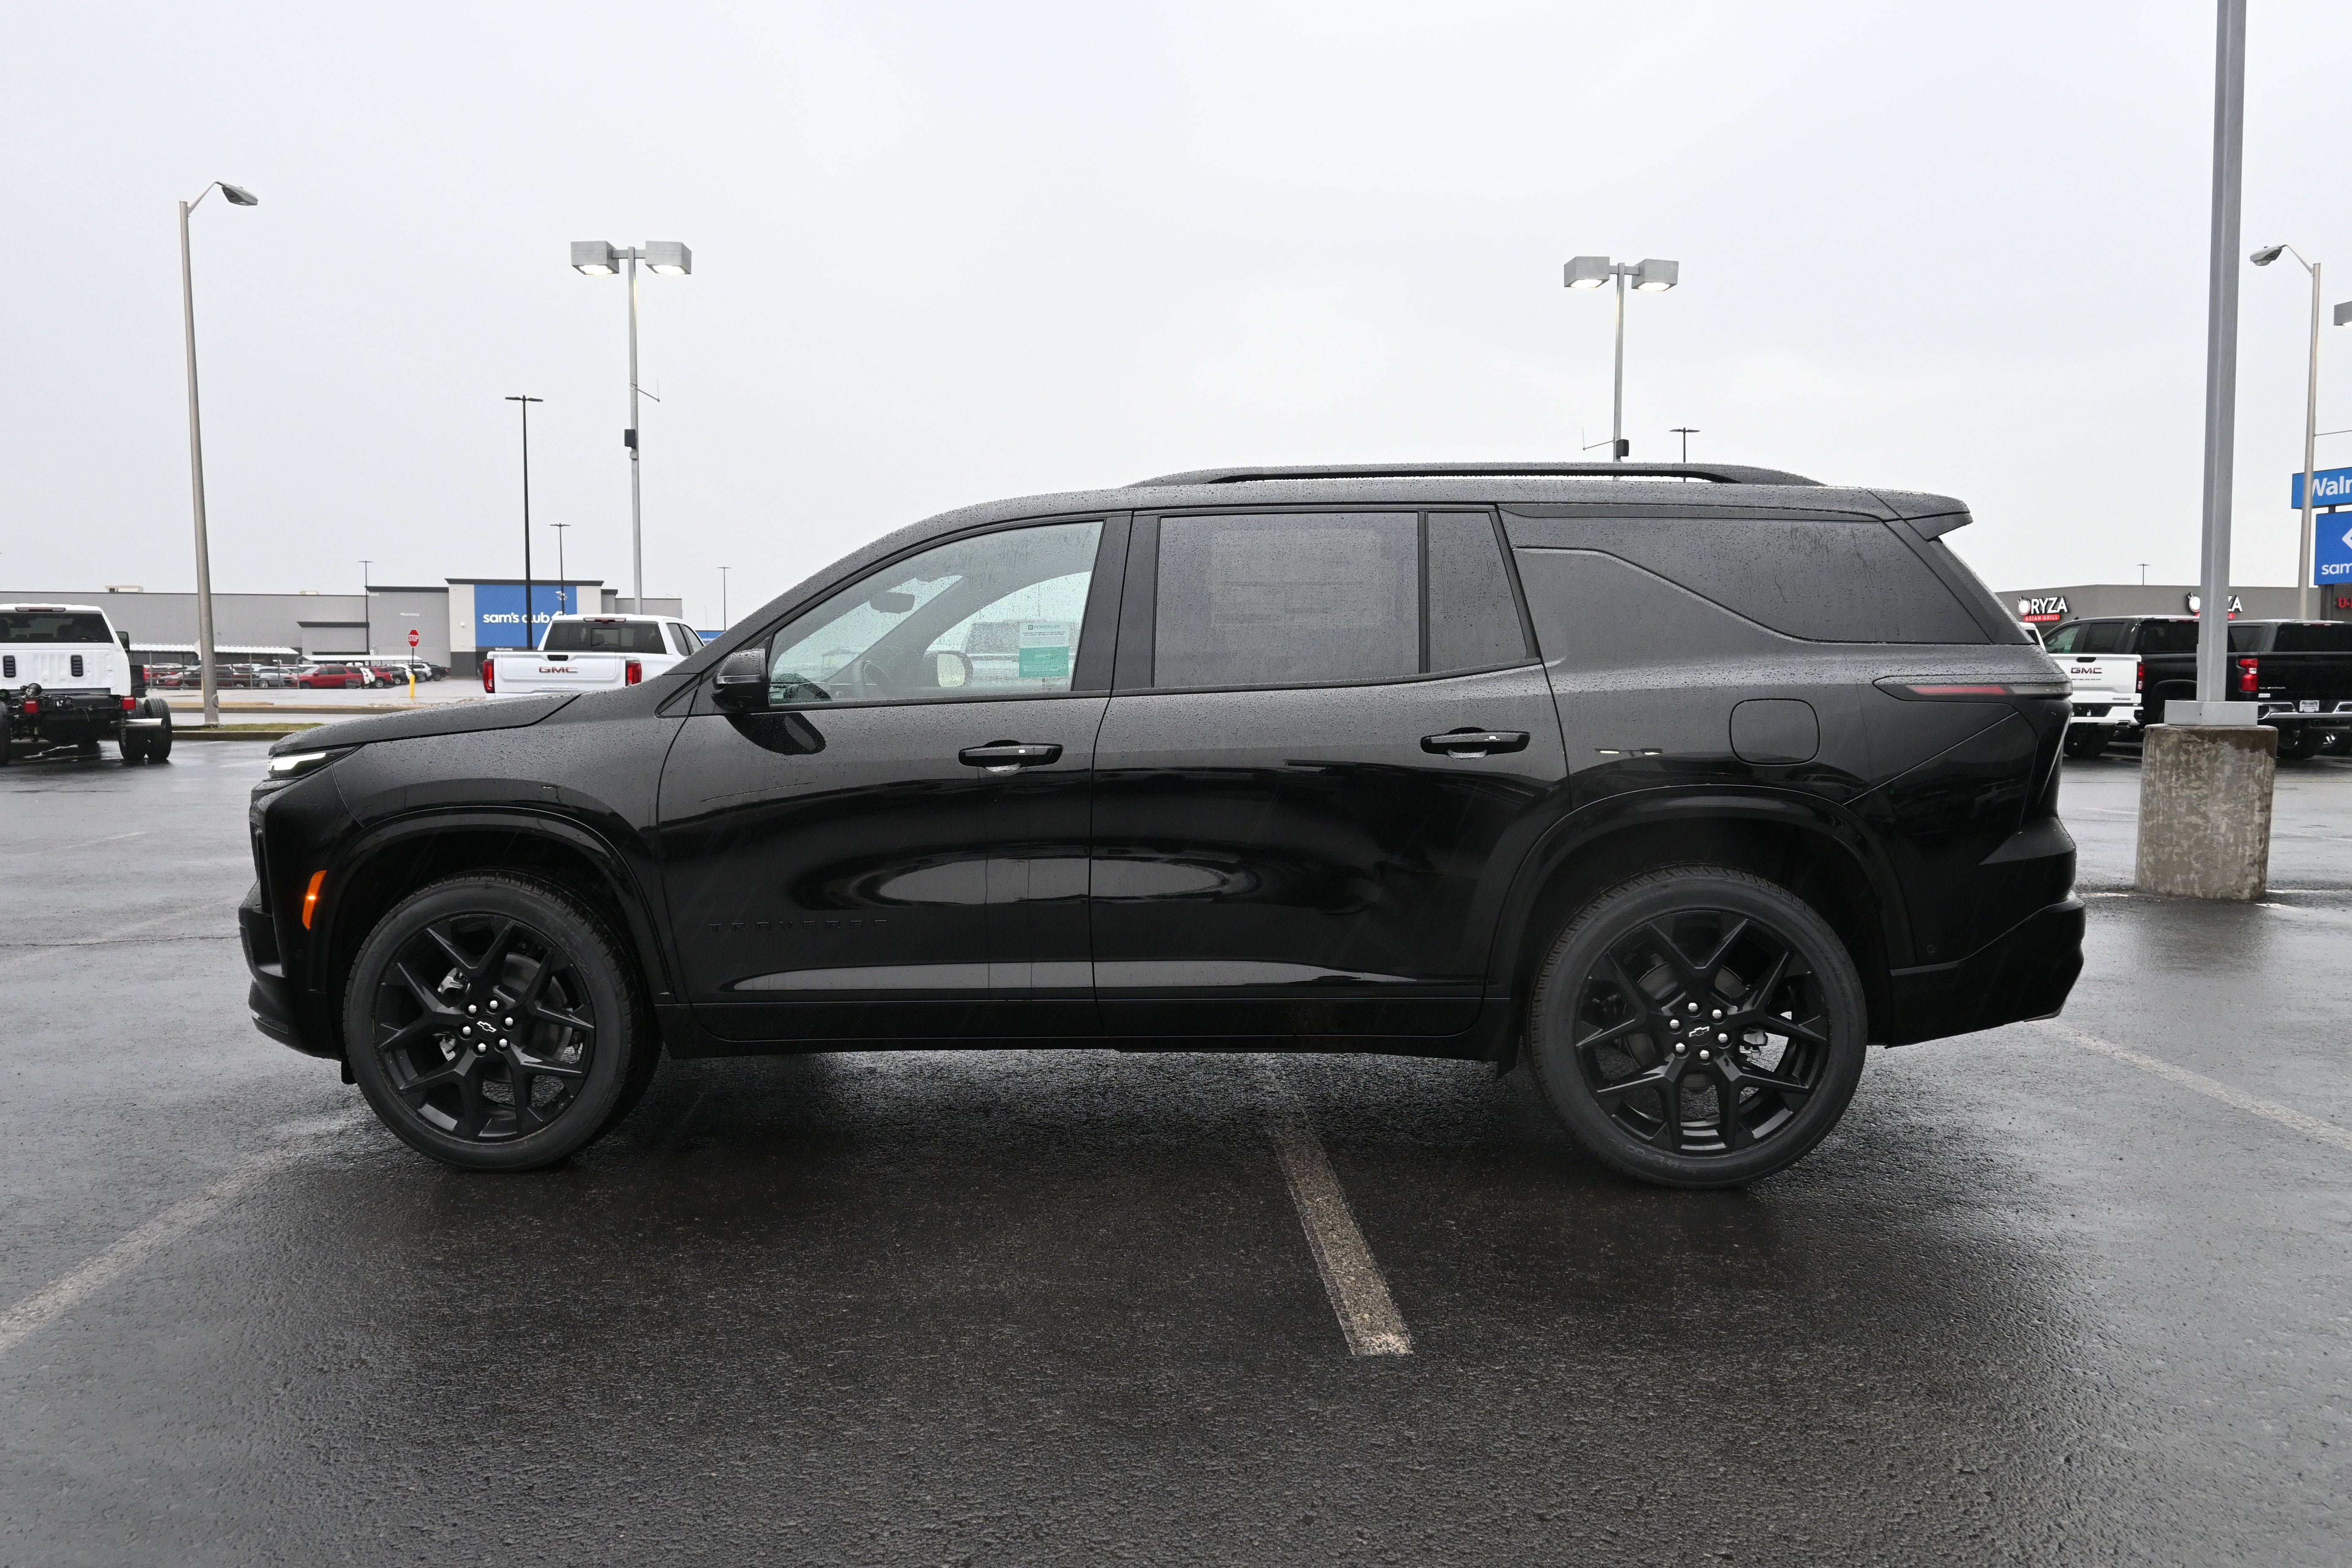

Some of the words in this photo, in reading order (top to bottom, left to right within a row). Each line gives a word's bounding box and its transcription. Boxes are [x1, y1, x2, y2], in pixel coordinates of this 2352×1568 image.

[483, 612, 520, 623] sam's
[522, 612, 550, 623] cub
[707, 920, 887, 932] TRAVERSE
